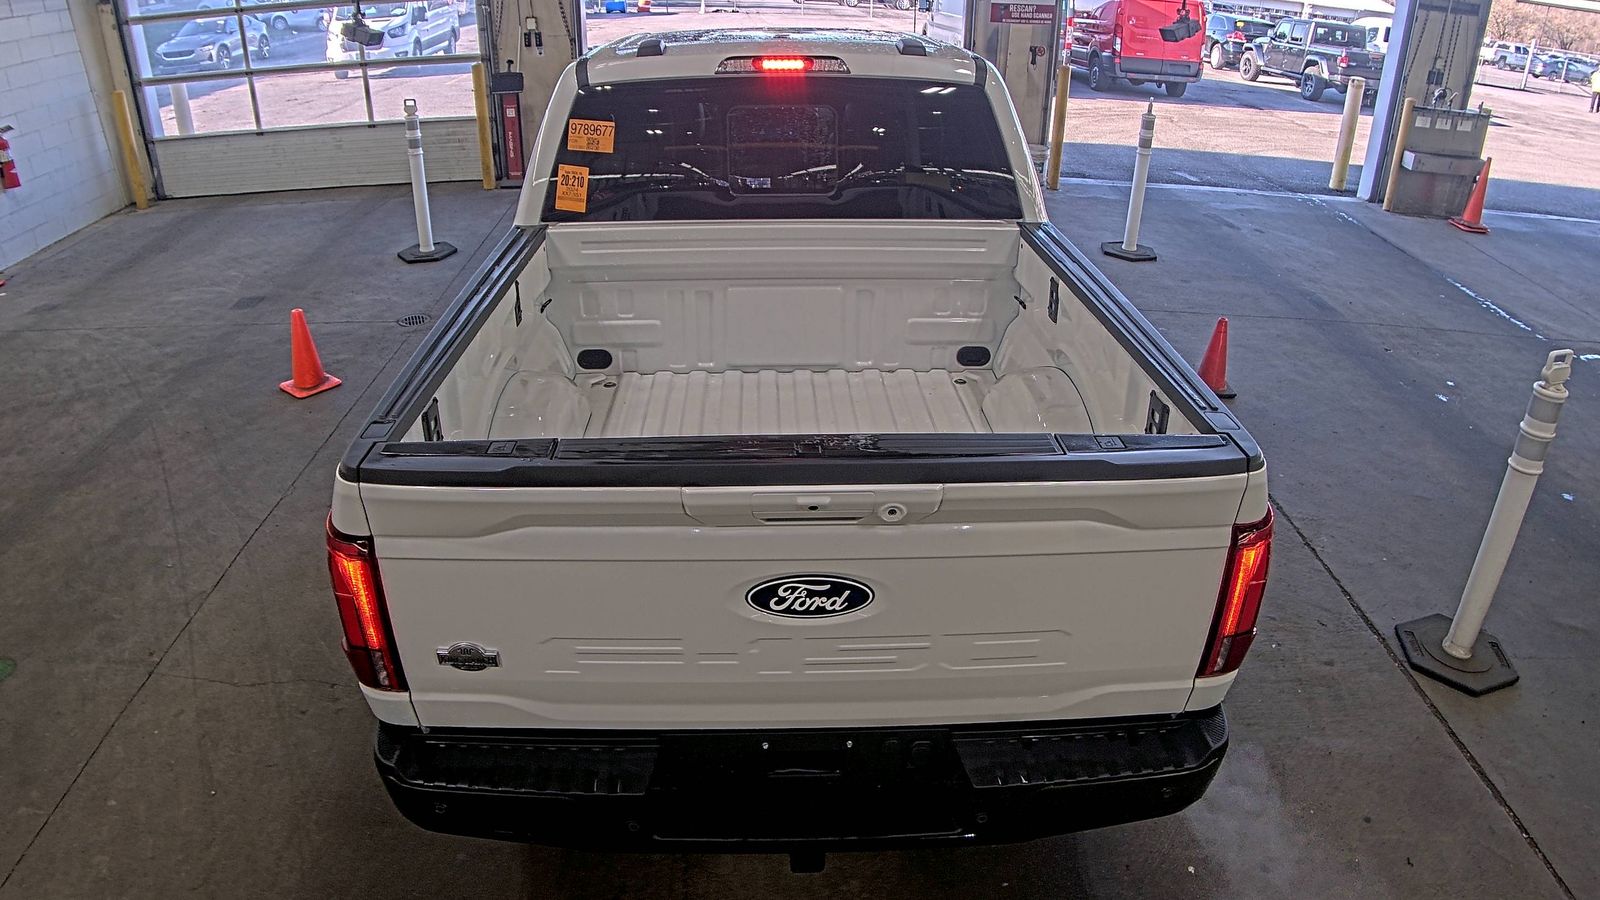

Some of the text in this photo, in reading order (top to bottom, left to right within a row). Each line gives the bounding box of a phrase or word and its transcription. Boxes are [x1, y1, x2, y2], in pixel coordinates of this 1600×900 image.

[1010, 5, 1036, 13] RESCAN?
[570, 122, 614, 137] 9789677
[560, 174, 585, 188] 20:210
[769, 583, 851, 611] Ford
